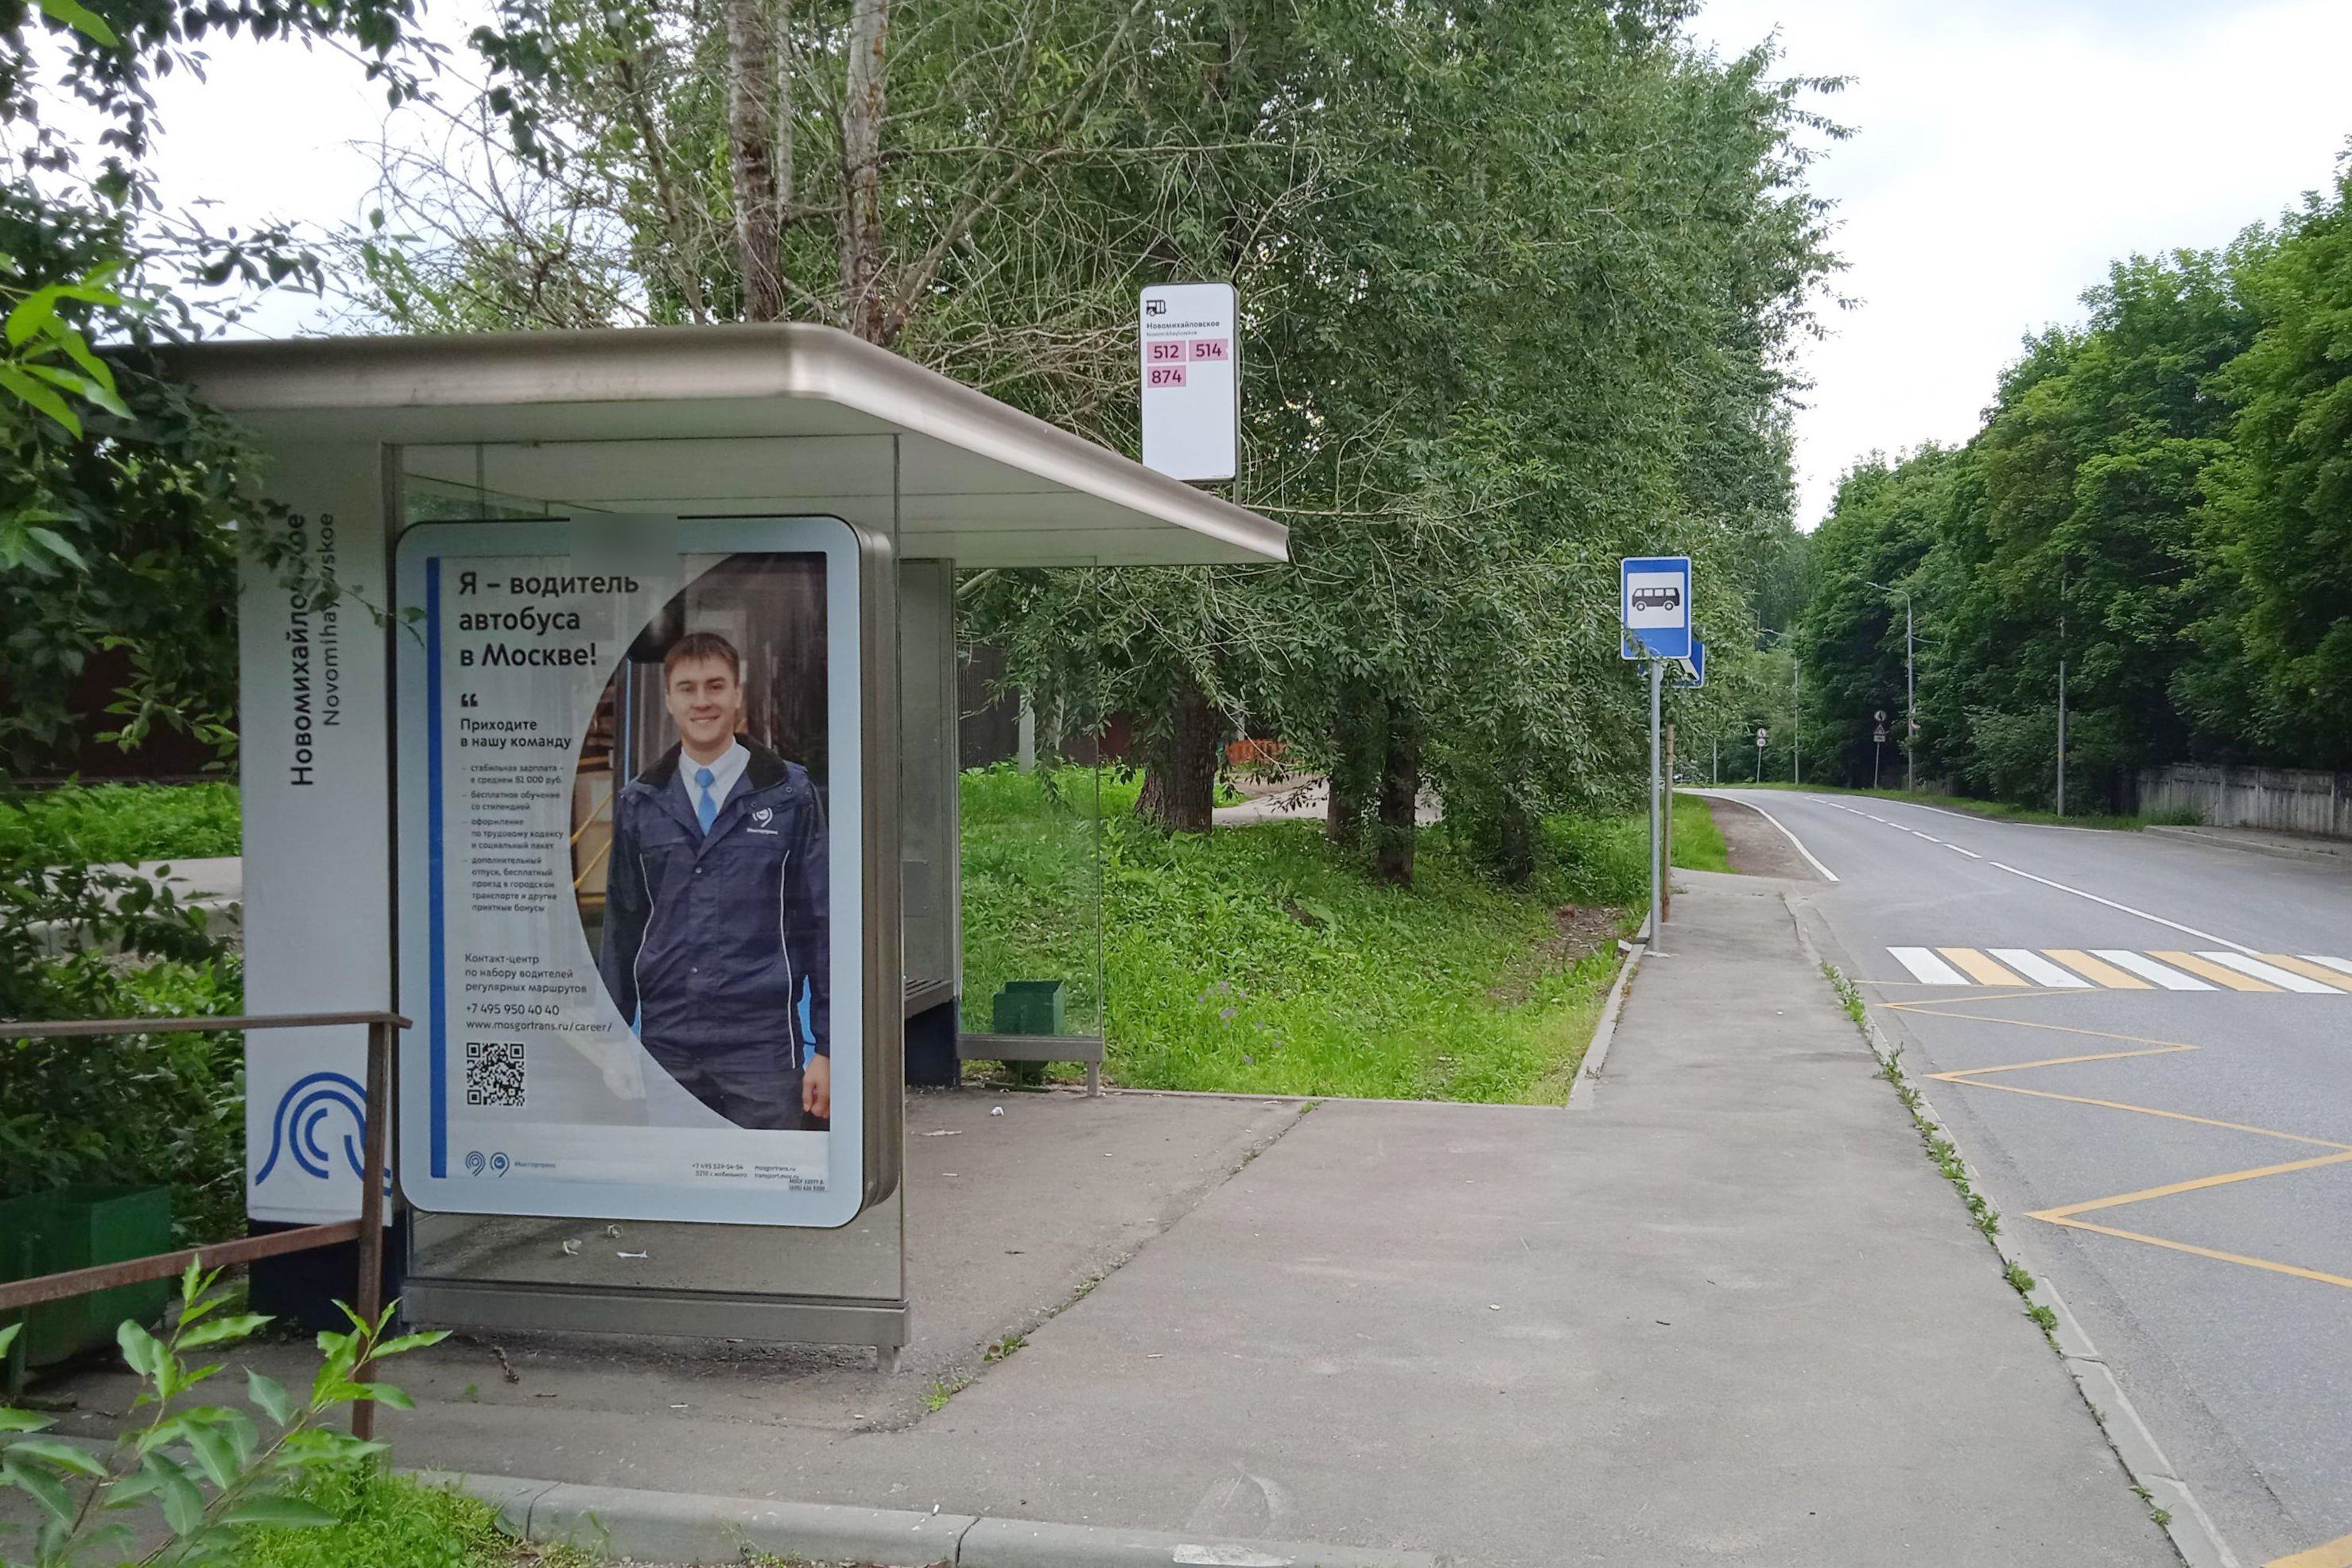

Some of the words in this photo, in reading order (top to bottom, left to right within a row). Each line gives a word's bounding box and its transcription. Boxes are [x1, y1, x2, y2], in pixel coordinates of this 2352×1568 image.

[1154, 345, 1179, 359] 512
[1196, 343, 1222, 357] 514
[1151, 370, 1182, 383] 874
[459, 571, 477, 595] Я
[510, 576, 639, 597] водитель
[317, 513, 340, 726] Novomihayvskoe
[459, 606, 580, 635] автобуса
[460, 649, 474, 666] в
[481, 642, 596, 666] Москве!
[460, 718, 538, 732] Приходите
[460, 737, 468, 747] в
[472, 737, 506, 750] нашу
[510, 737, 571, 750] команду
[519, 765, 557, 774] зарплата
[477, 776, 513, 785] среднем
[471, 790, 518, 799] бесплатное
[520, 790, 561, 801] обучение
[471, 817, 524, 826] оформление
[483, 830, 528, 839] трудовому
[530, 831, 563, 840] кодексу
[479, 841, 529, 850] социальный
[503, 867, 553, 876] бесплатный
[472, 880, 502, 889] проезд
[472, 892, 518, 901] транспорте
[528, 893, 557, 902] другие
[514, 903, 545, 914] бонусы
[465, 953, 539, 965] Контакт-центр
[479, 968, 517, 979] набору
[519, 968, 573, 979] водителей
[465, 983, 526, 993] регулярных
[528, 984, 587, 994] маршрутов
[466, 1003, 477, 1014] +7
[480, 1003, 501, 1015] 495
[503, 1004, 525, 1015] 950
[528, 1004, 542, 1015] 40
[545, 1004, 560, 1015] 40
[466, 1020, 612, 1033] www.mosgortrans.ru/career/
